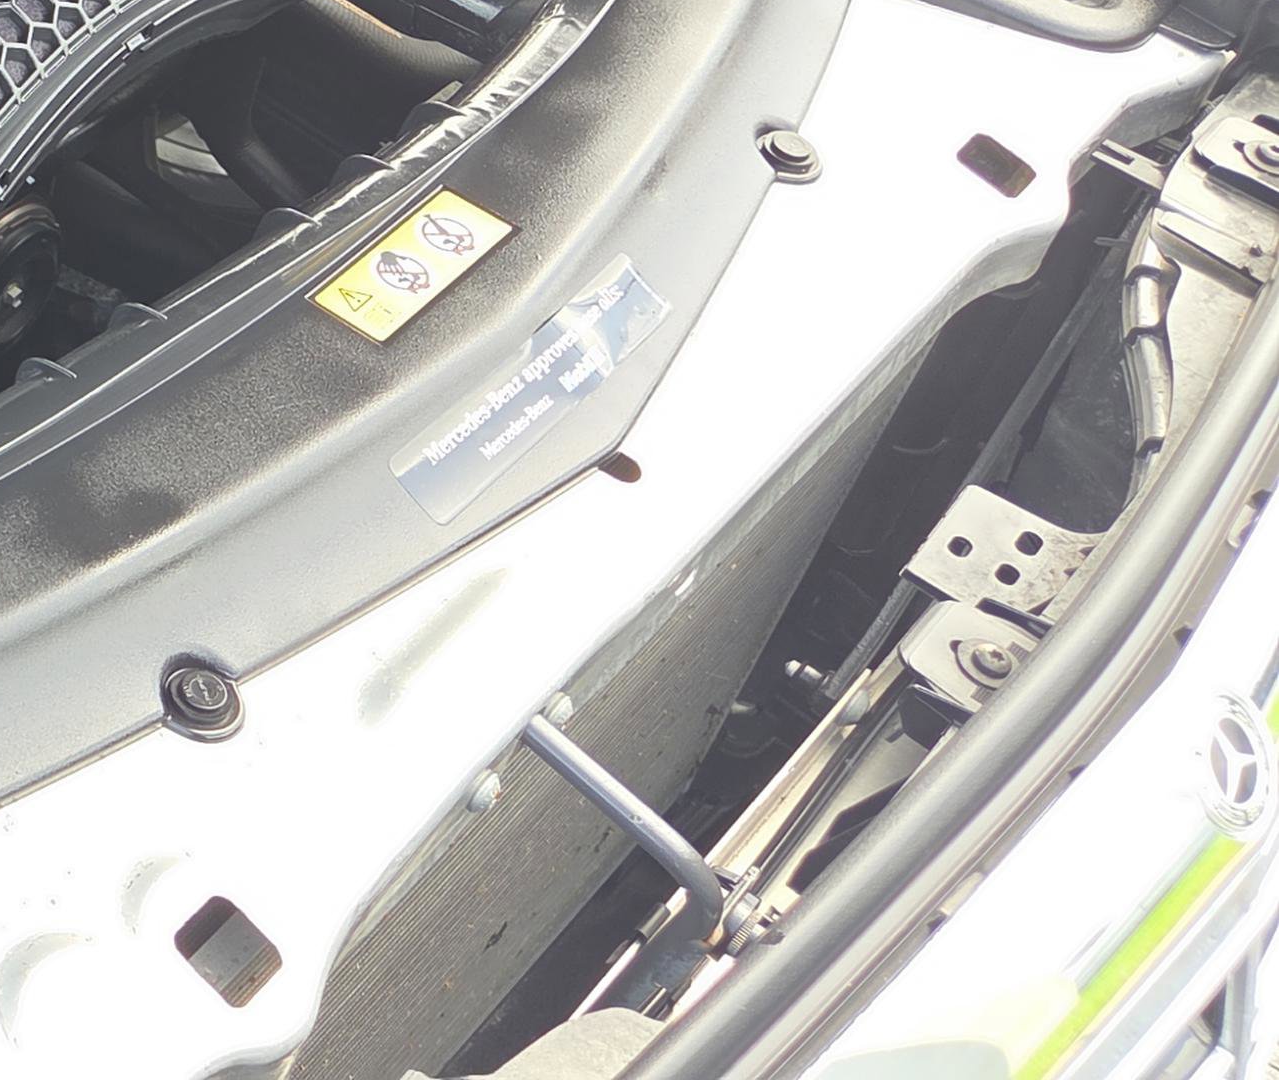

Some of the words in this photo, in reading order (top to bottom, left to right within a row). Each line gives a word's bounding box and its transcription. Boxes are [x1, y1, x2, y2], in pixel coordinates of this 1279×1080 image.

[422, 376, 525, 466] Mercedes-Benz
[522, 328, 580, 383] approves
[479, 394, 554, 461] Mercedes-Benz
